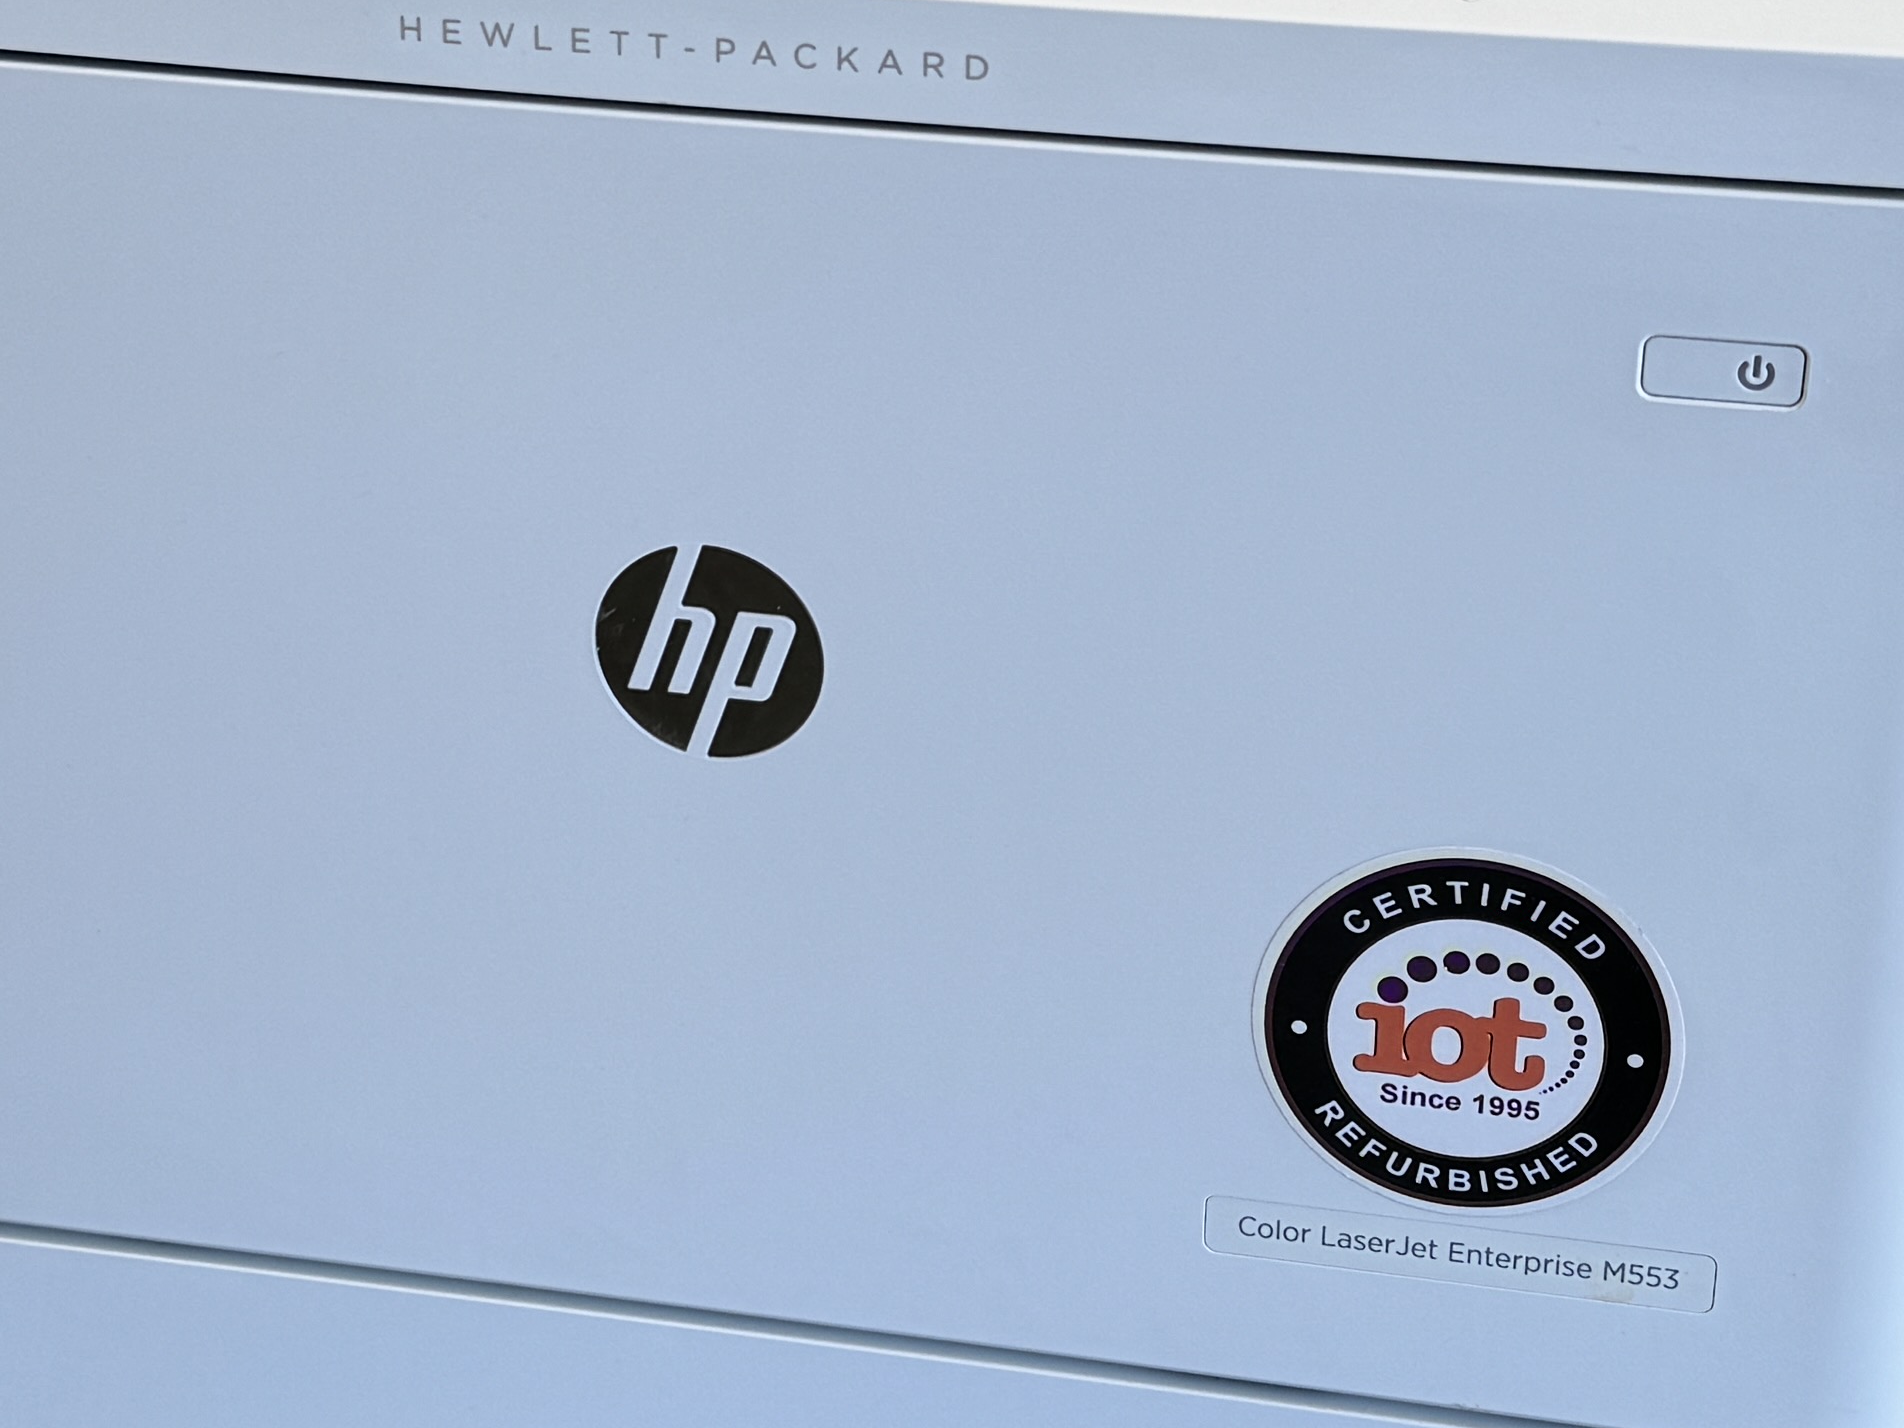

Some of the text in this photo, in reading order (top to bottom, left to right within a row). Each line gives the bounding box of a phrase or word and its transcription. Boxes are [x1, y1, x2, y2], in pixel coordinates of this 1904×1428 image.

[398, 14, 991, 82] HEWLETT-PACKARD
[626, 544, 797, 758] hp
[1342, 879, 1608, 963] CERTIFIED
[1351, 976, 1548, 1092] iot
[1379, 1082, 1542, 1122] Since 1995
[1313, 1098, 1600, 1194] REFURBISHED
[1237, 1215, 1681, 1292] Color LaserJet Enterprise M553
